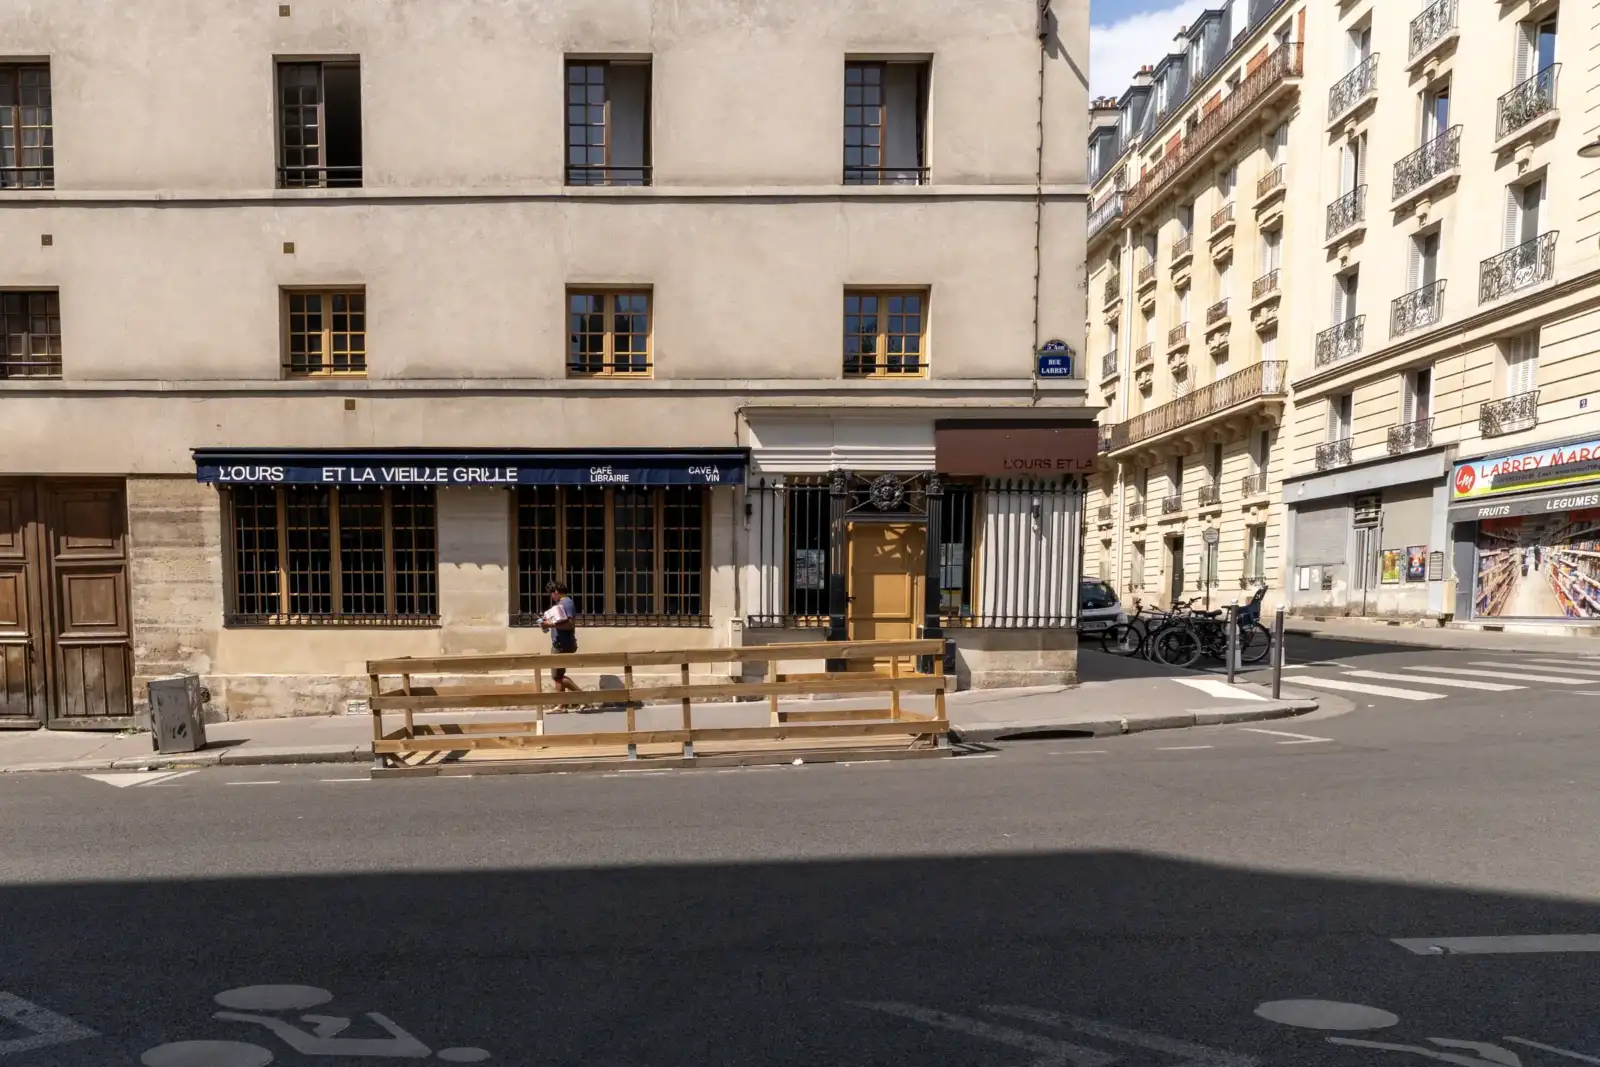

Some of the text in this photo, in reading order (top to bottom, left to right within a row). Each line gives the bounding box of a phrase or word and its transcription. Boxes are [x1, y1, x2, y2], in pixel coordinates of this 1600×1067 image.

[1003, 458, 1093, 469] L'OURS ET LA
[1481, 456, 1544, 479] LARREY
[219, 466, 518, 482] L'OURS ET LA VIEILLE GRILLE
[590, 465, 612, 474] CAFÉ
[688, 466, 711, 475] CAVE
[590, 474, 629, 482] LIBRAIRIE
[705, 474, 720, 482] VIN
[1477, 494, 1599, 517] FRUITS LEGUMES
